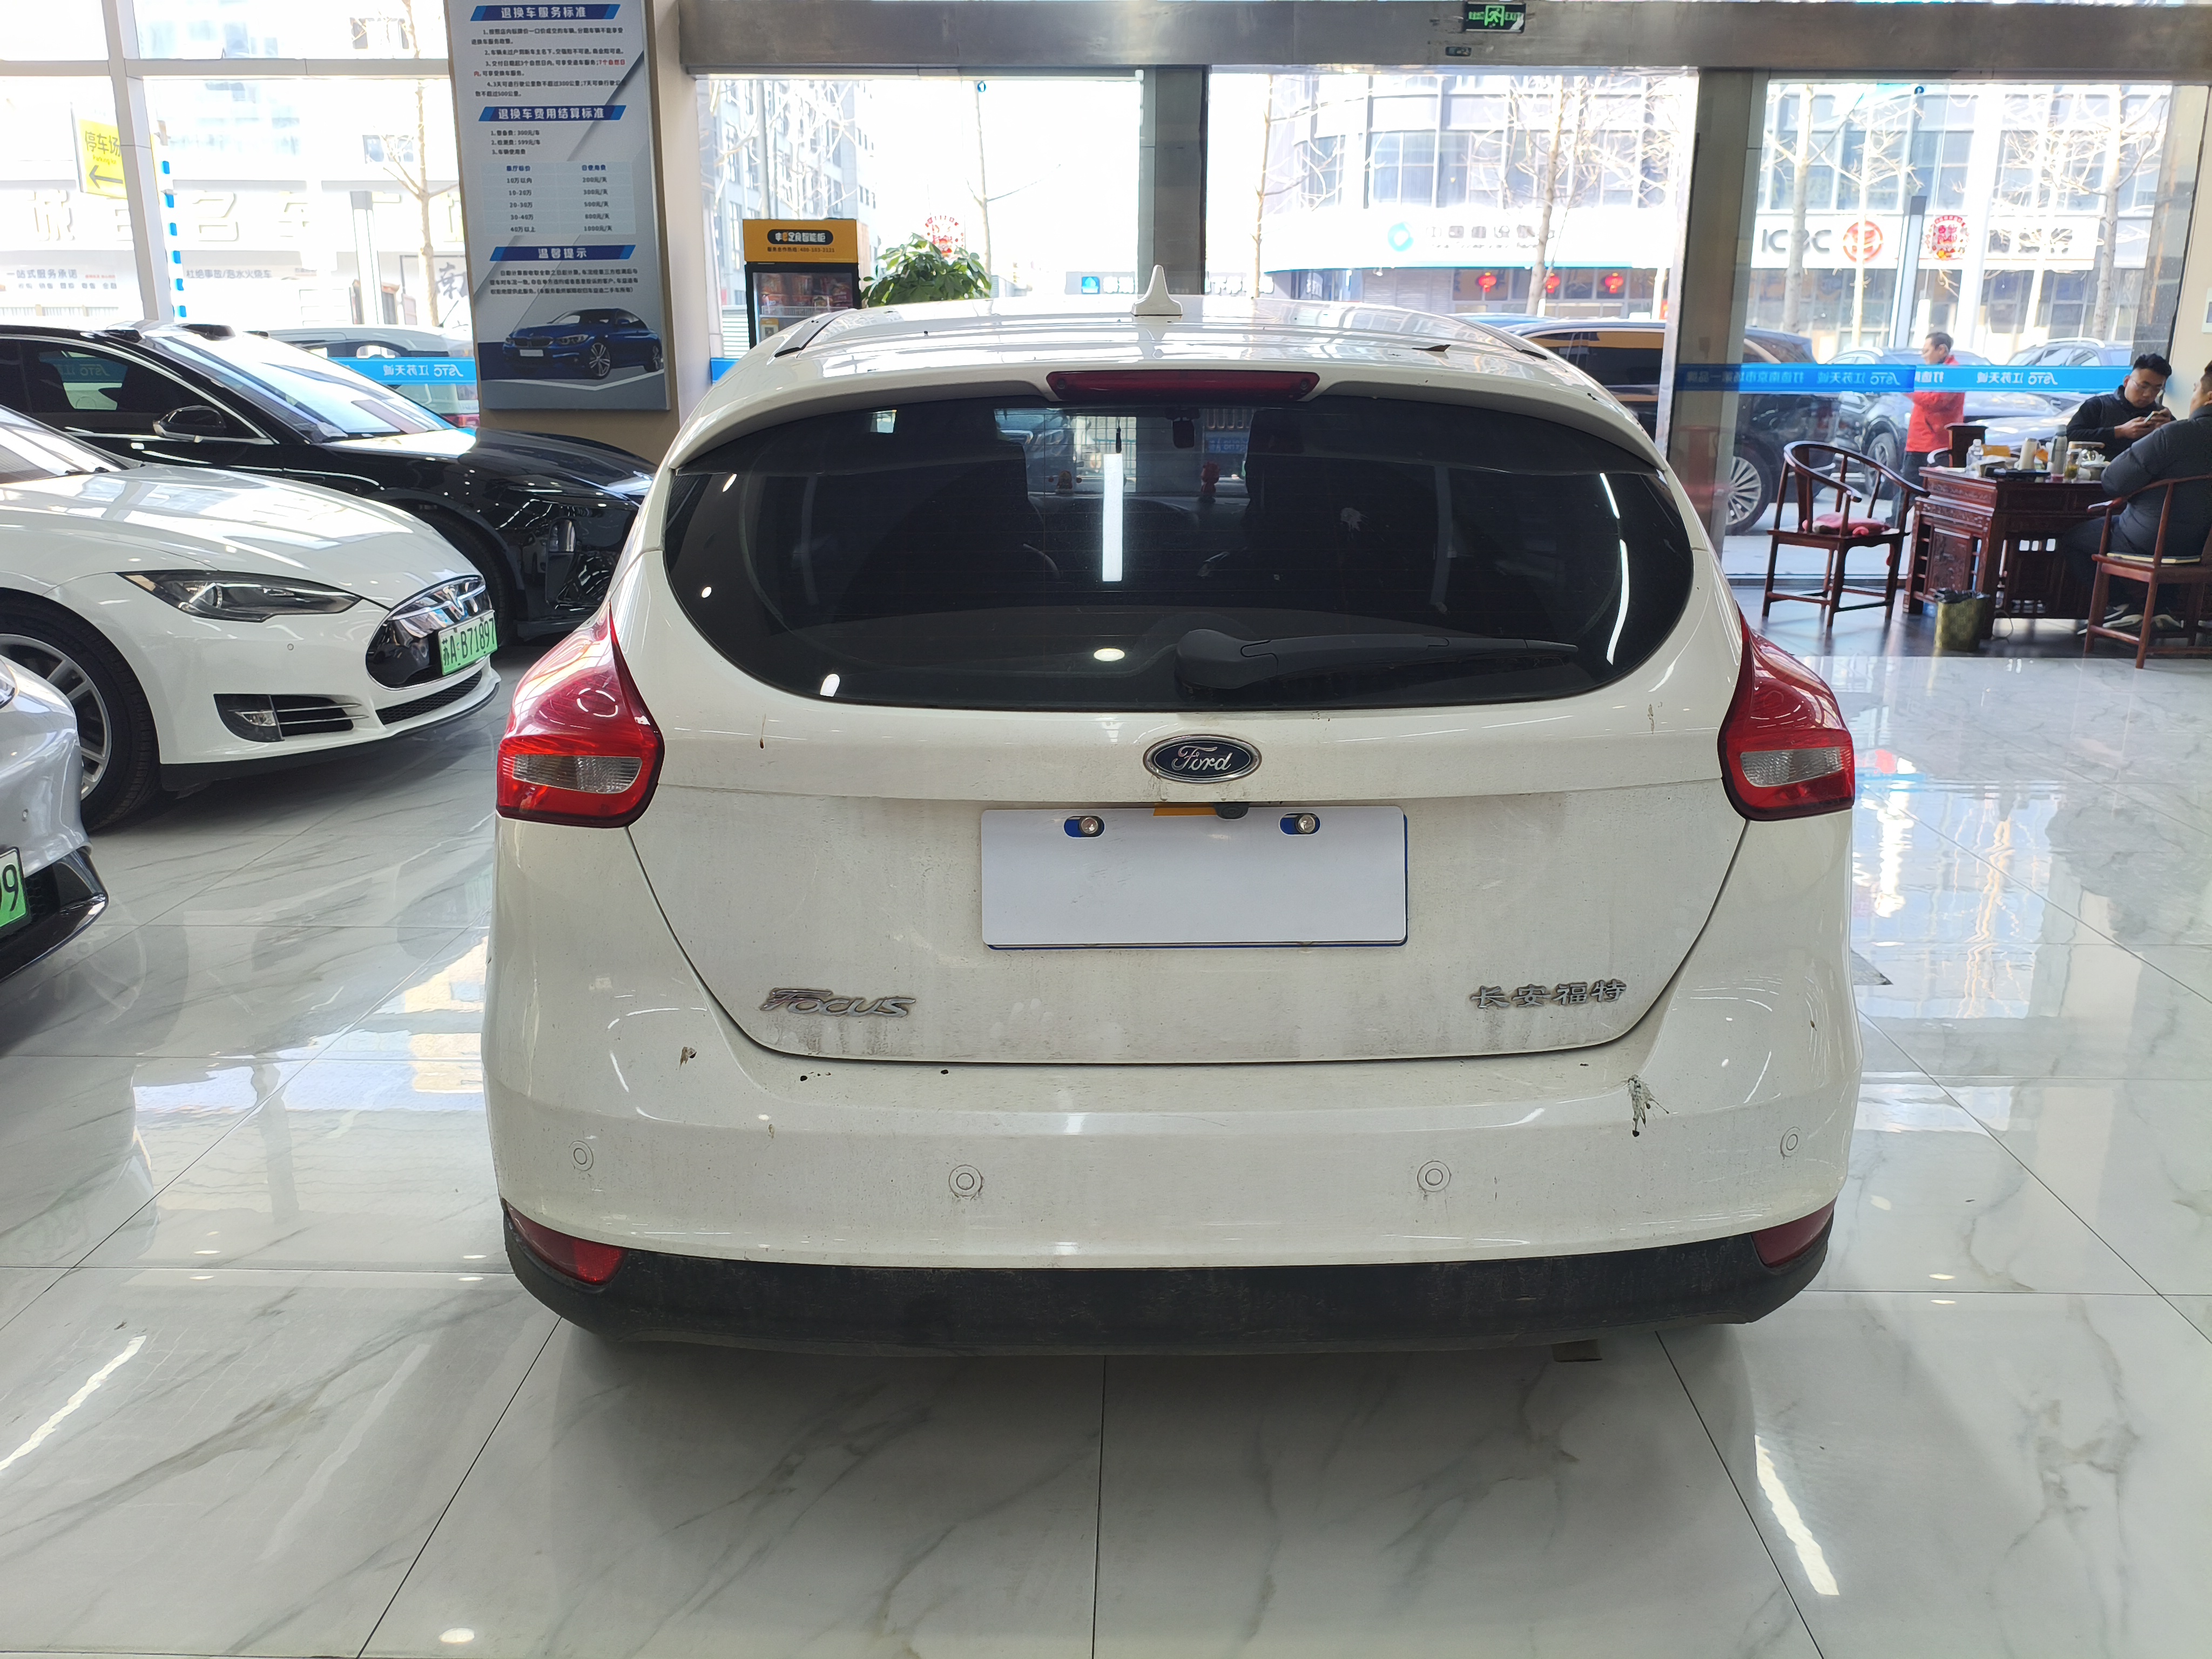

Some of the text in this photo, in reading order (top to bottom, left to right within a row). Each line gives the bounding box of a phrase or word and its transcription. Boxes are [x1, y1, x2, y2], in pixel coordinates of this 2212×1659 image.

[501, 6, 586, 18] 退换车服务标准
[498, 108, 604, 119] 退换车费用结算标准
[1171, 745, 1233, 771] Ford
[759, 987, 916, 1017] Focus
[1469, 978, 1627, 1009] 长安福特
